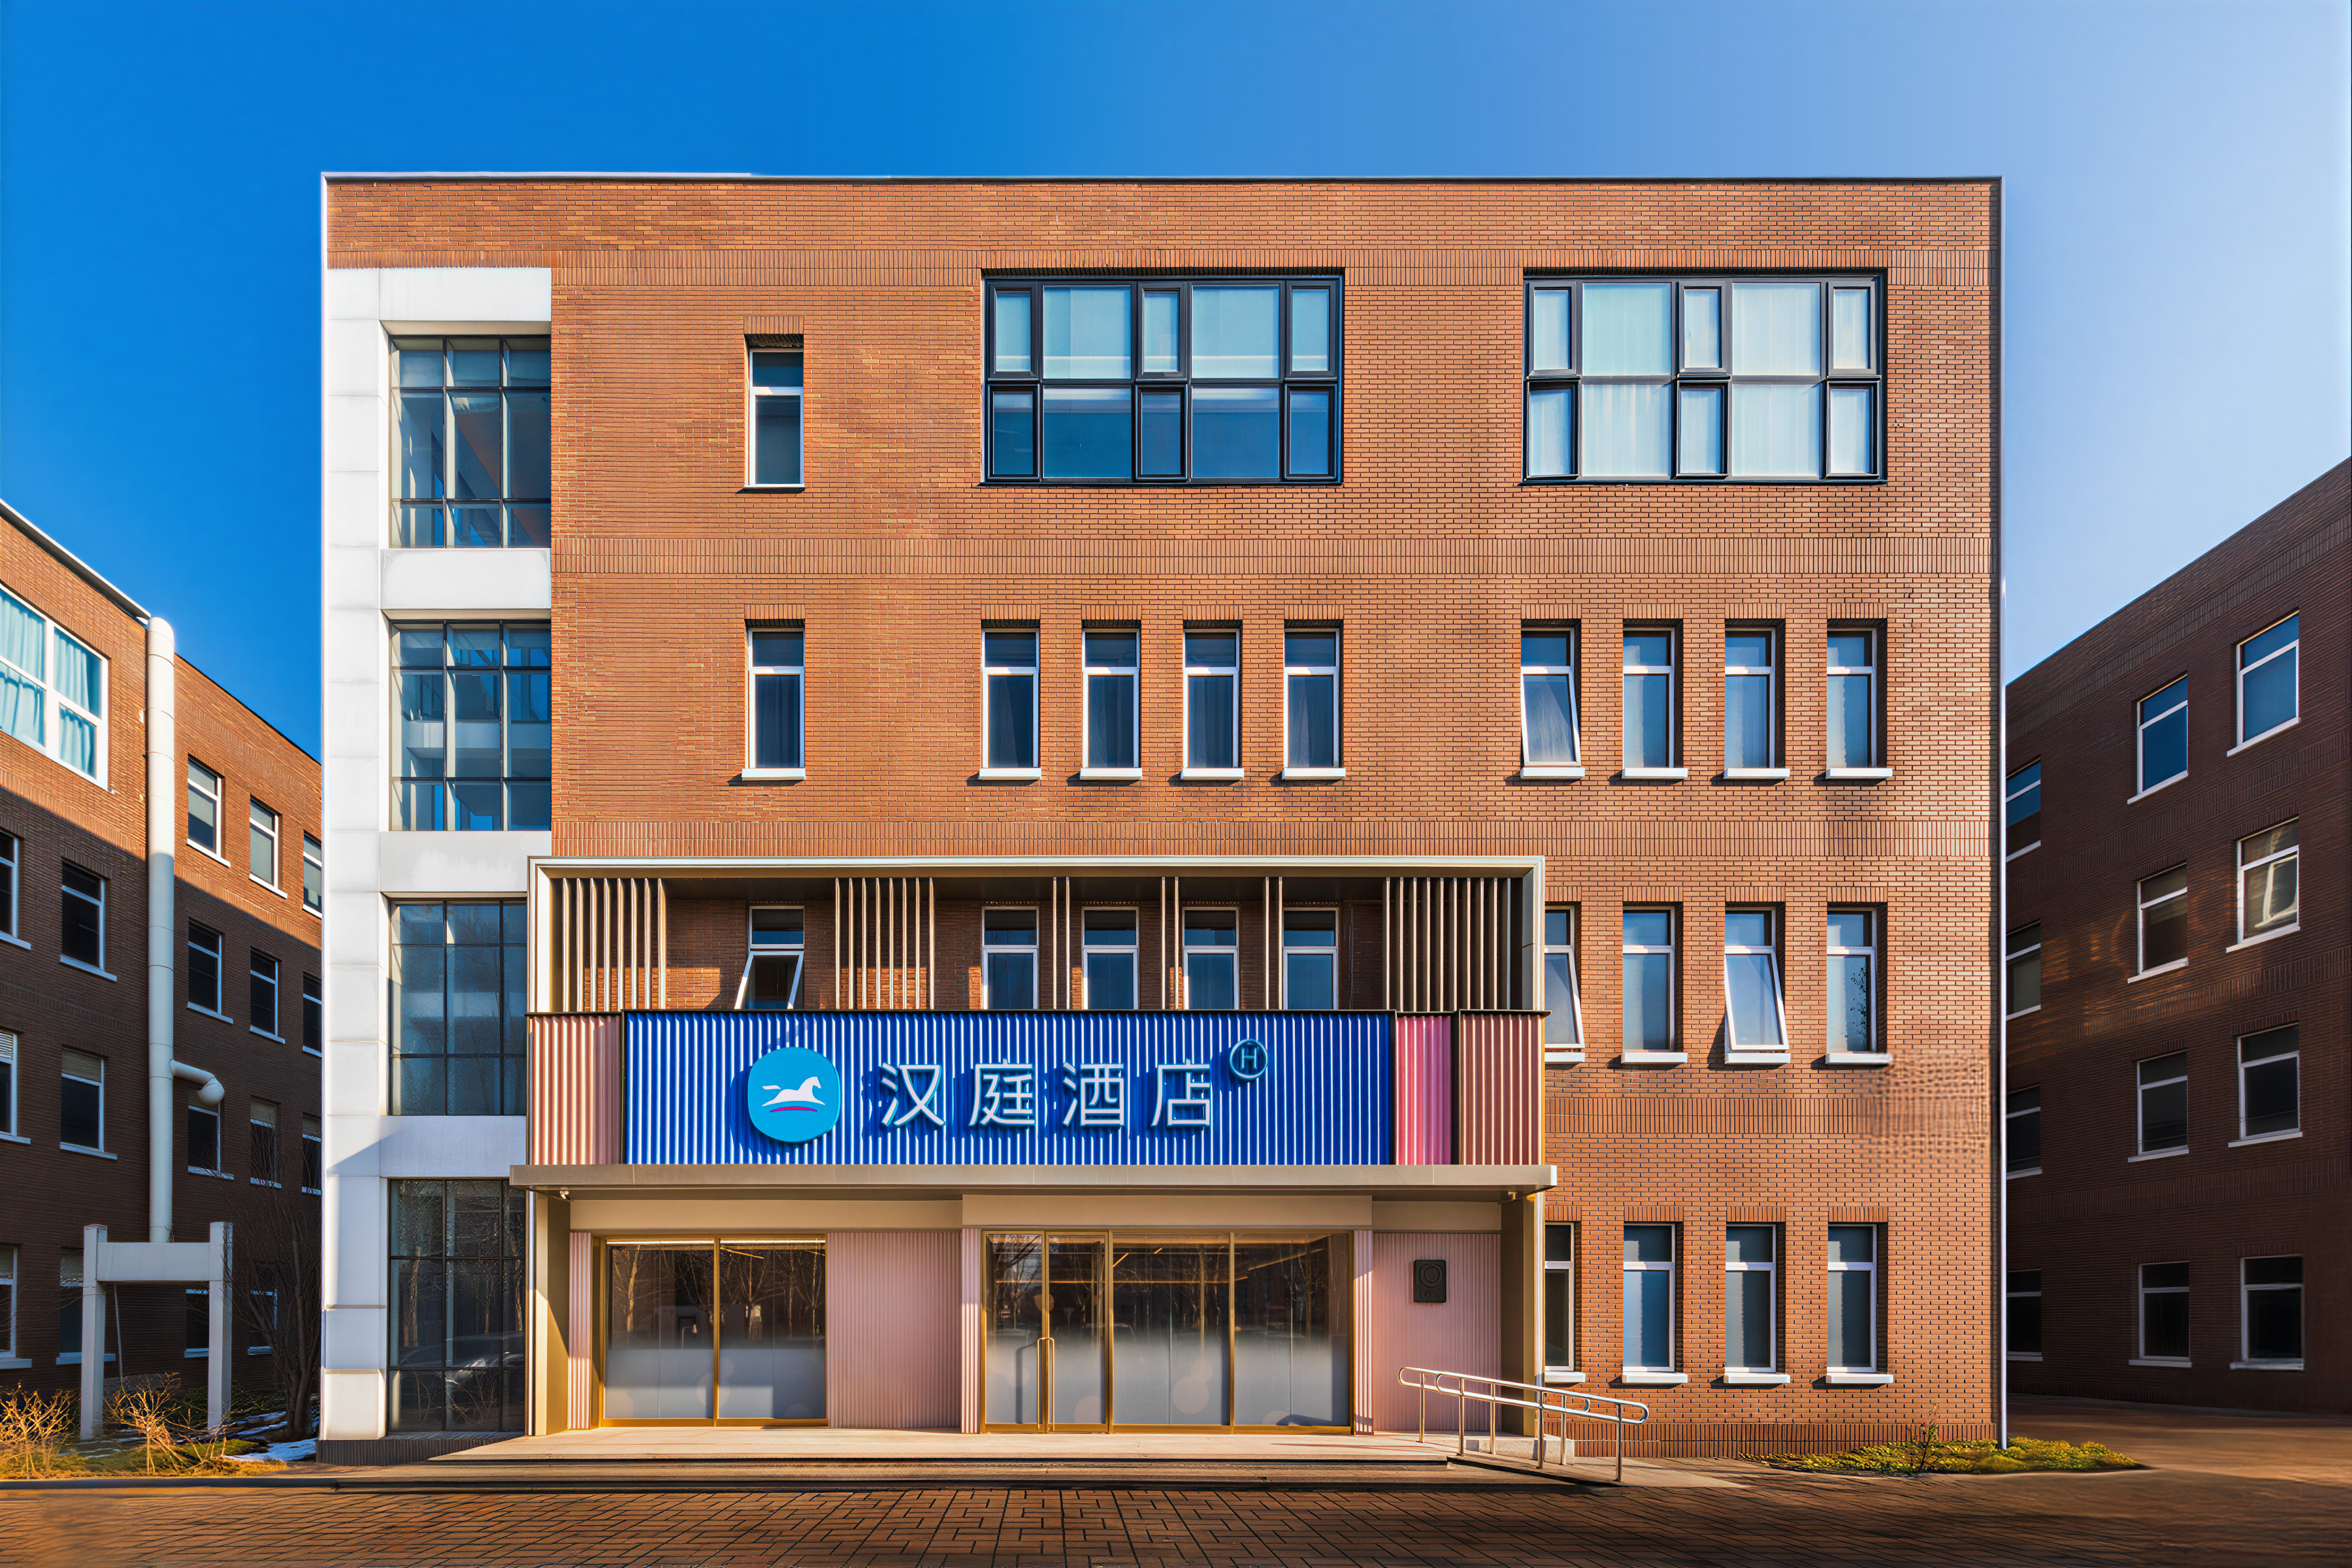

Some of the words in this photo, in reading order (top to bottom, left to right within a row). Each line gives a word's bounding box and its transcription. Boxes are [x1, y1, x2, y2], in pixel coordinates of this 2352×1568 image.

[1241, 1047, 1258, 1070] H
[881, 1058, 1210, 1126] 汉庭酒店
